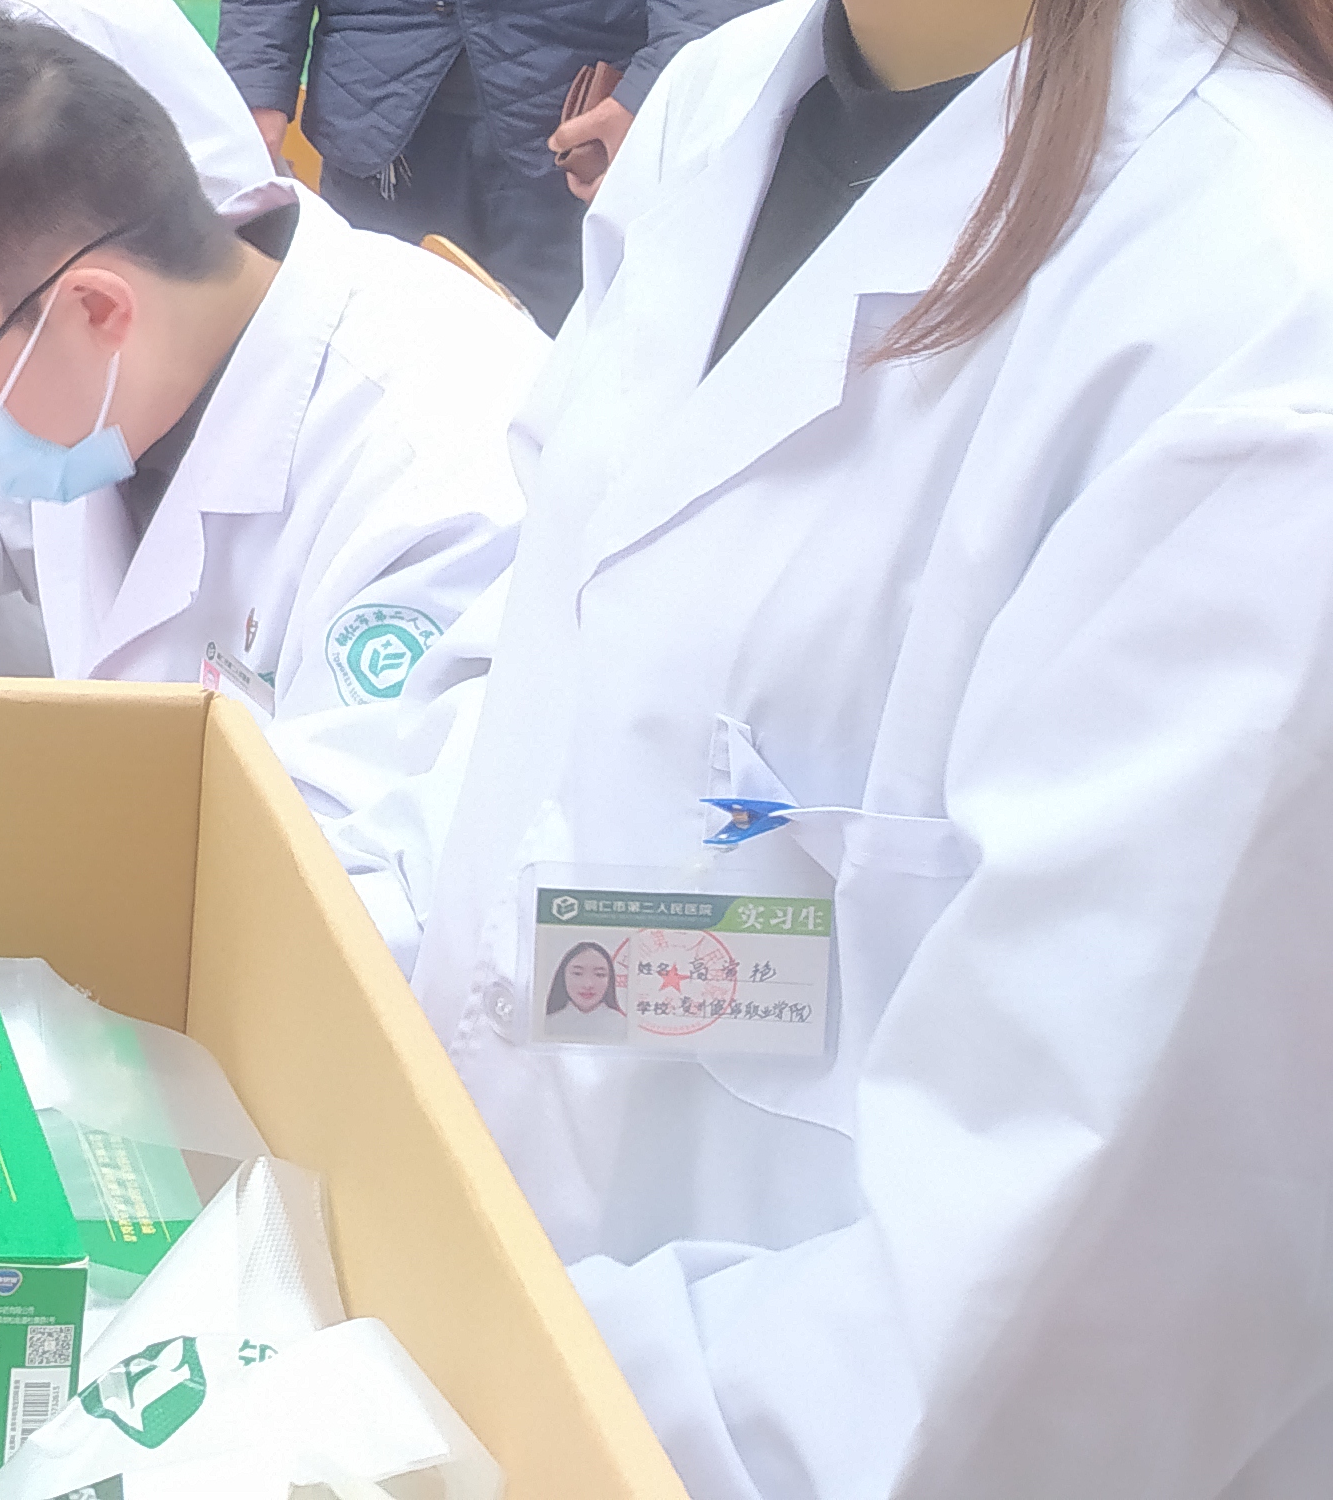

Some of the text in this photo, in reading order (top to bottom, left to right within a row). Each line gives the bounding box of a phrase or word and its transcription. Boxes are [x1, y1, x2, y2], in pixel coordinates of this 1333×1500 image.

[584, 900, 714, 917] 铜仁市第二人民医院
[737, 903, 824, 931] 实习生
